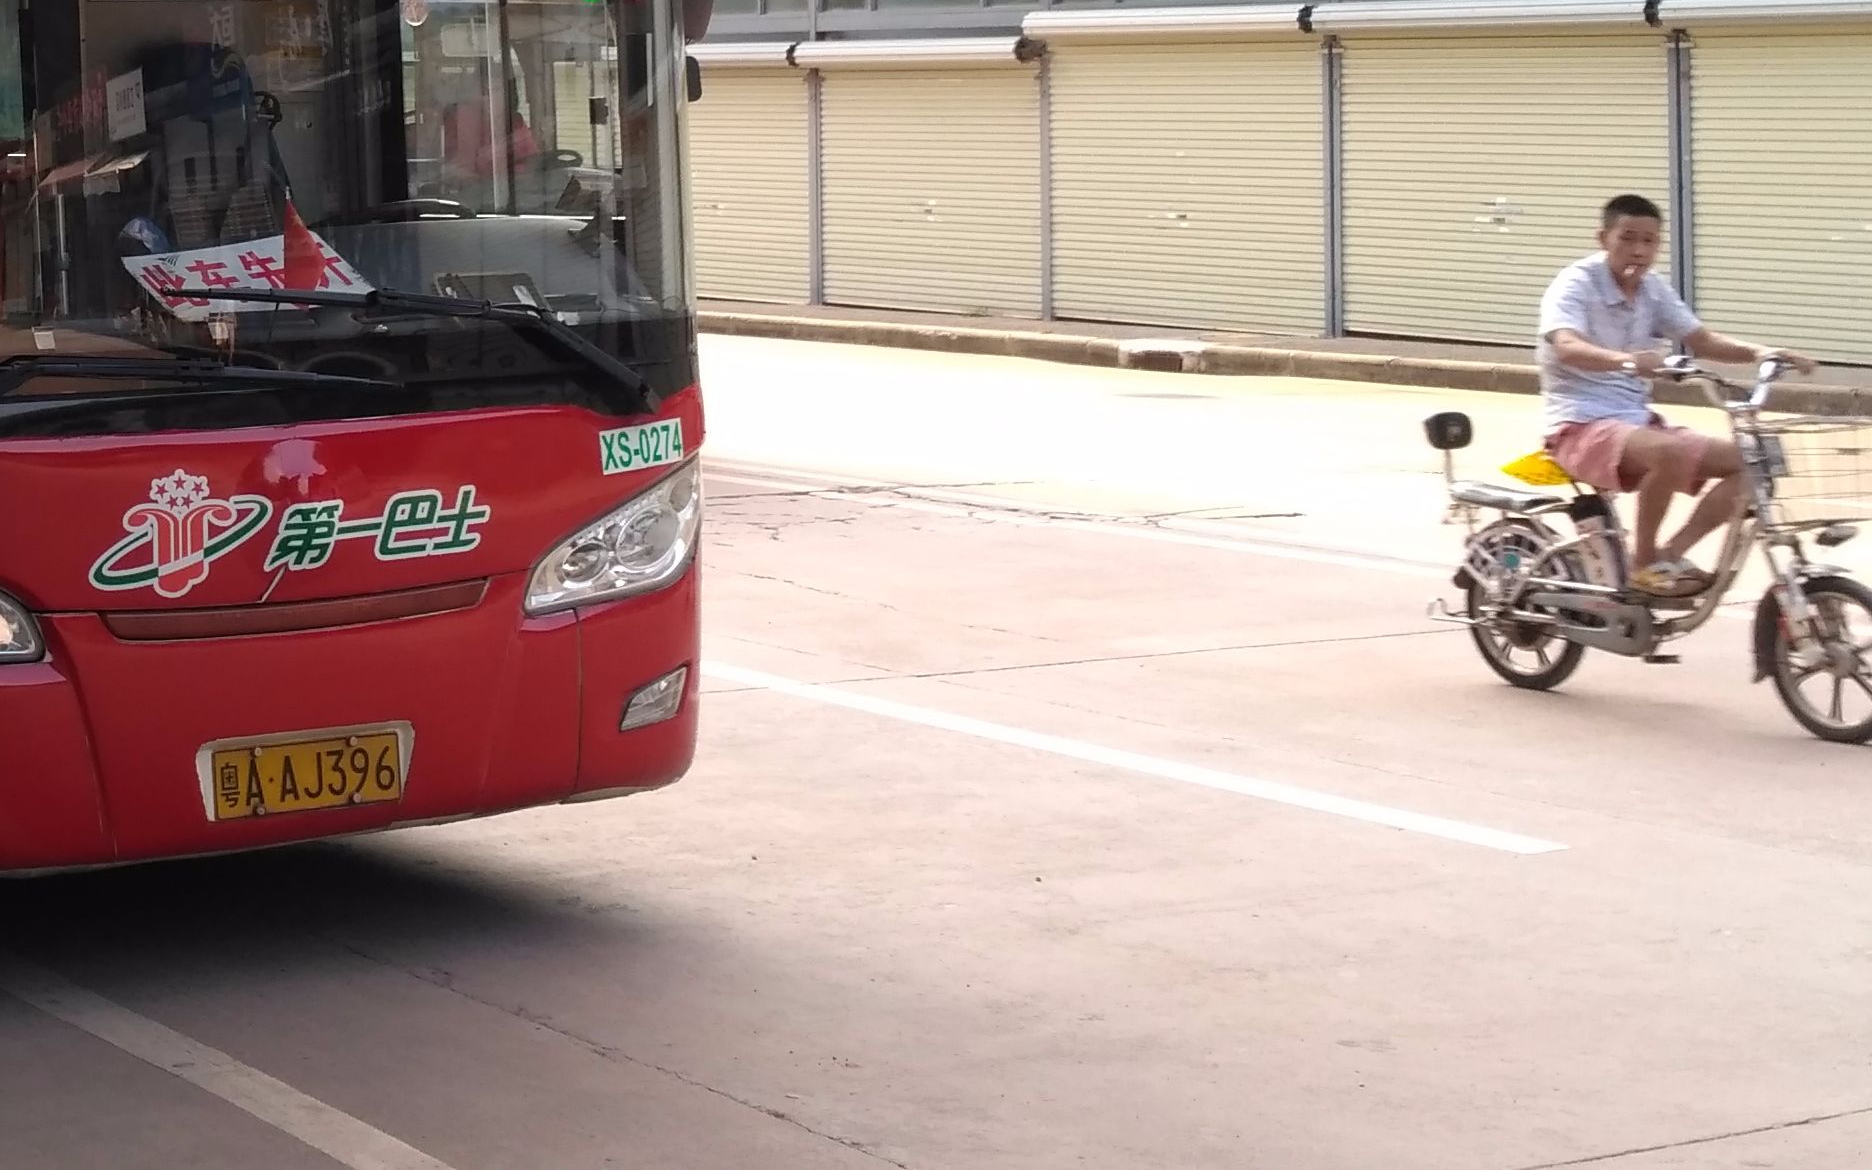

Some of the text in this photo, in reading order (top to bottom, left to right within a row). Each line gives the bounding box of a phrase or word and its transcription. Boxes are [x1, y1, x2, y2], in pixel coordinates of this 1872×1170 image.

[601, 421, 681, 471] XS-0274
[266, 487, 488, 568] 第一巴士
